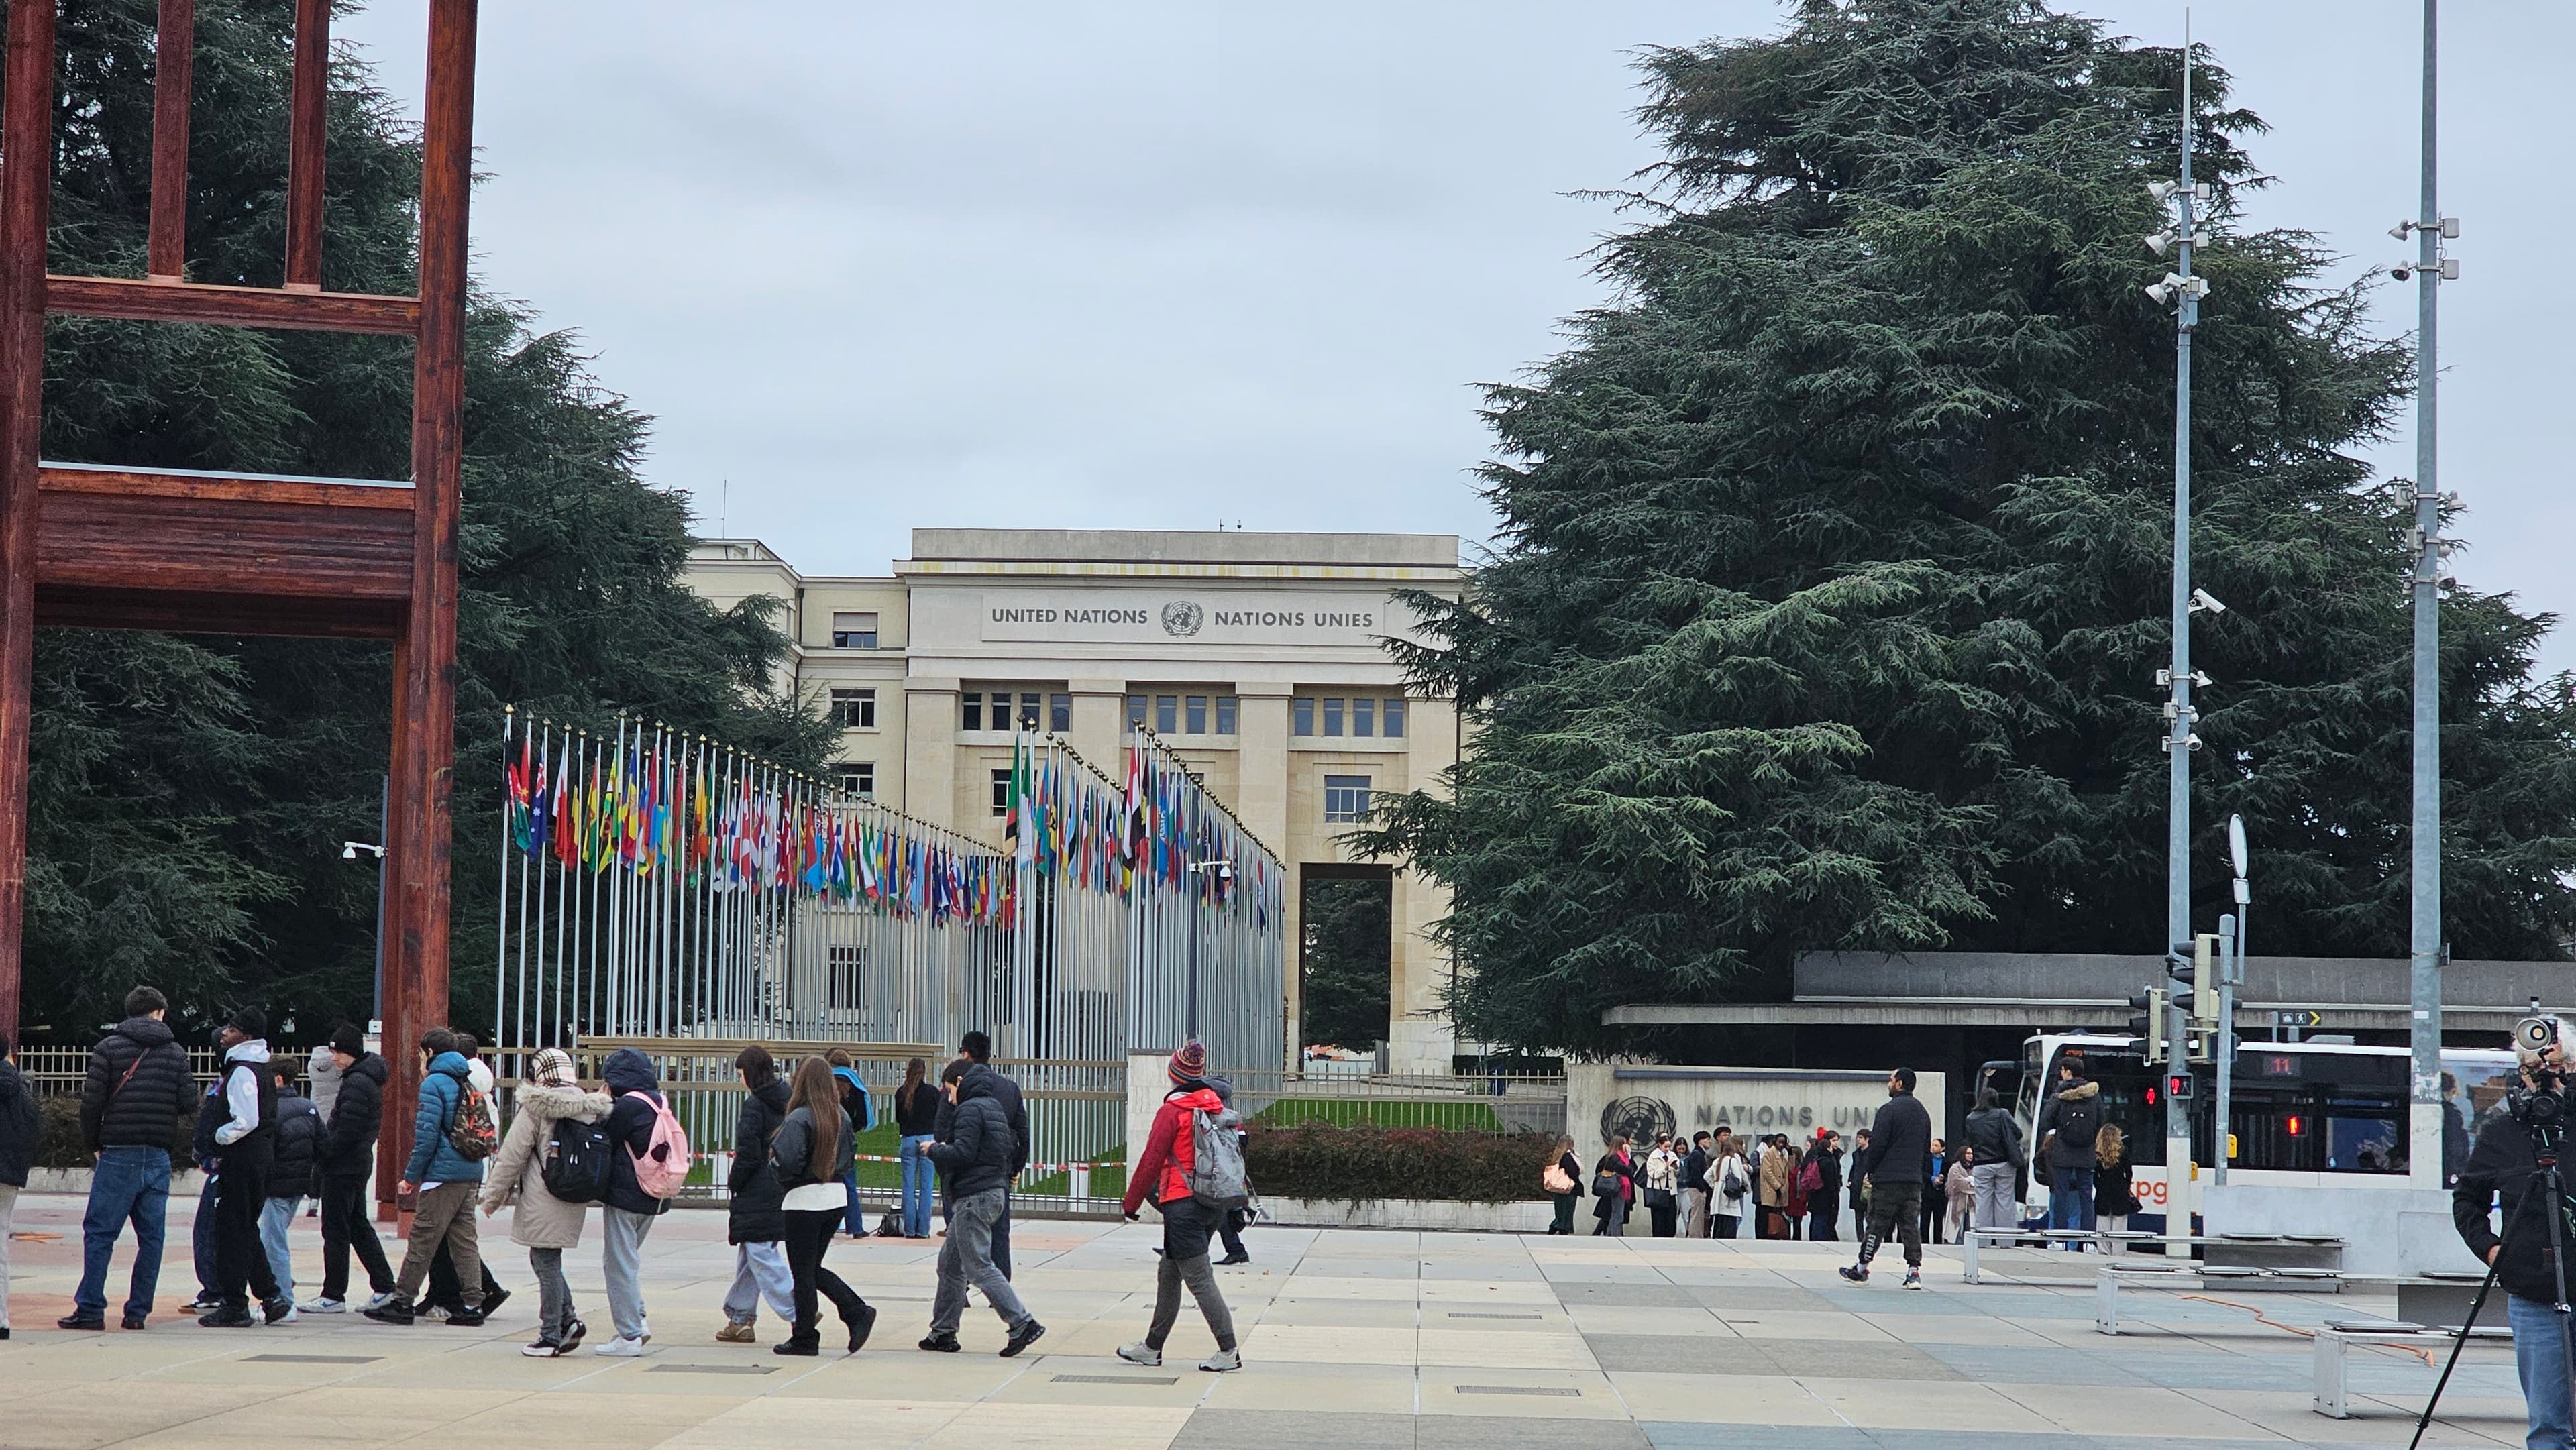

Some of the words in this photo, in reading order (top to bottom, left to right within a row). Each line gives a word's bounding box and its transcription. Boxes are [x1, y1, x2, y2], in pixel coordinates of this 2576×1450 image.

[992, 608, 1057, 622] UNITED
[1064, 609, 1148, 624] NATIONS
[1214, 611, 1305, 626] NATIONS
[1314, 612, 1373, 627] UNIES
[1697, 1105, 1813, 1127] NATIONS
[1834, 1106, 1878, 1127] UN
[2131, 1181, 2167, 1205] pg
